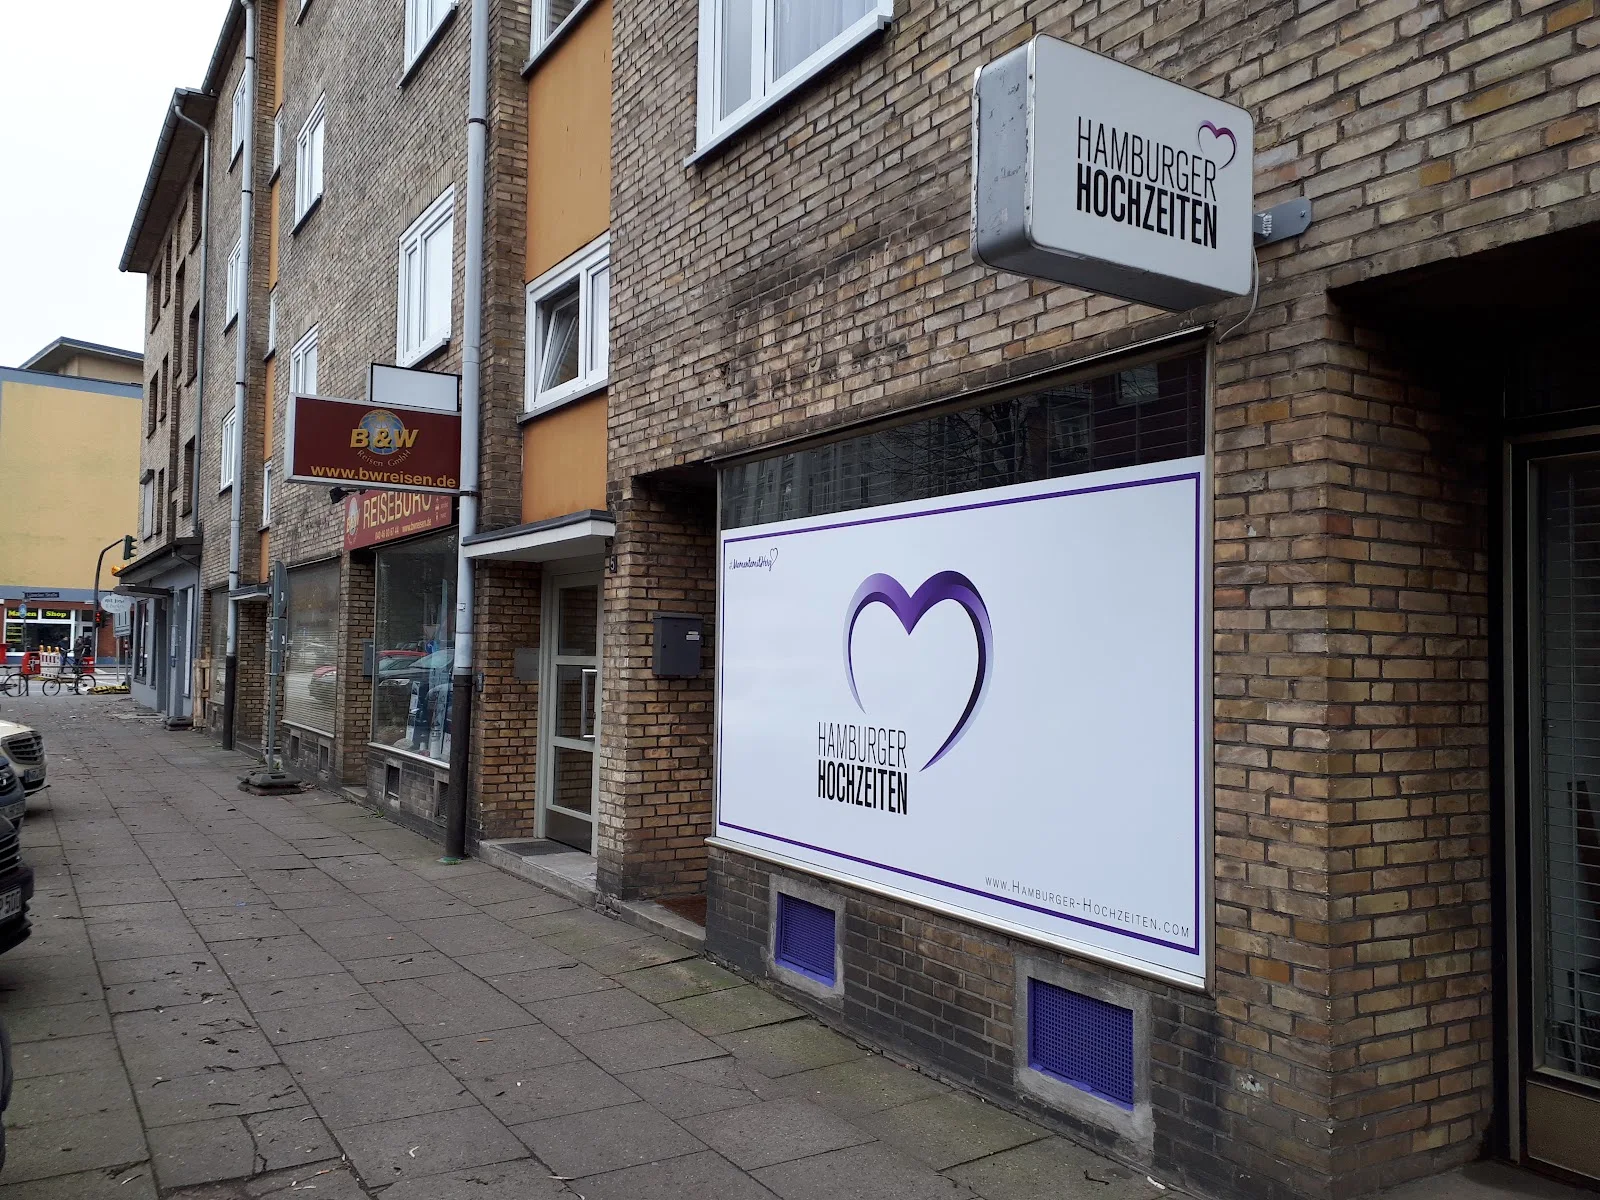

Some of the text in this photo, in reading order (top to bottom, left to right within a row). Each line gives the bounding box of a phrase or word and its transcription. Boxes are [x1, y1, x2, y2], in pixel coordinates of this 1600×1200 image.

[1077, 116, 1217, 202] HAMBURGER
[1076, 163, 1218, 249] HOCHZEITEN
[356, 449, 412, 467] Reisen GmbH
[310, 465, 457, 488] www.bwreisen.de
[610, 556, 615, 571] 5
[45, 610, 67, 618] Shop
[818, 721, 907, 769] HAMBURGER
[818, 759, 908, 816] HOCHZEITEN
